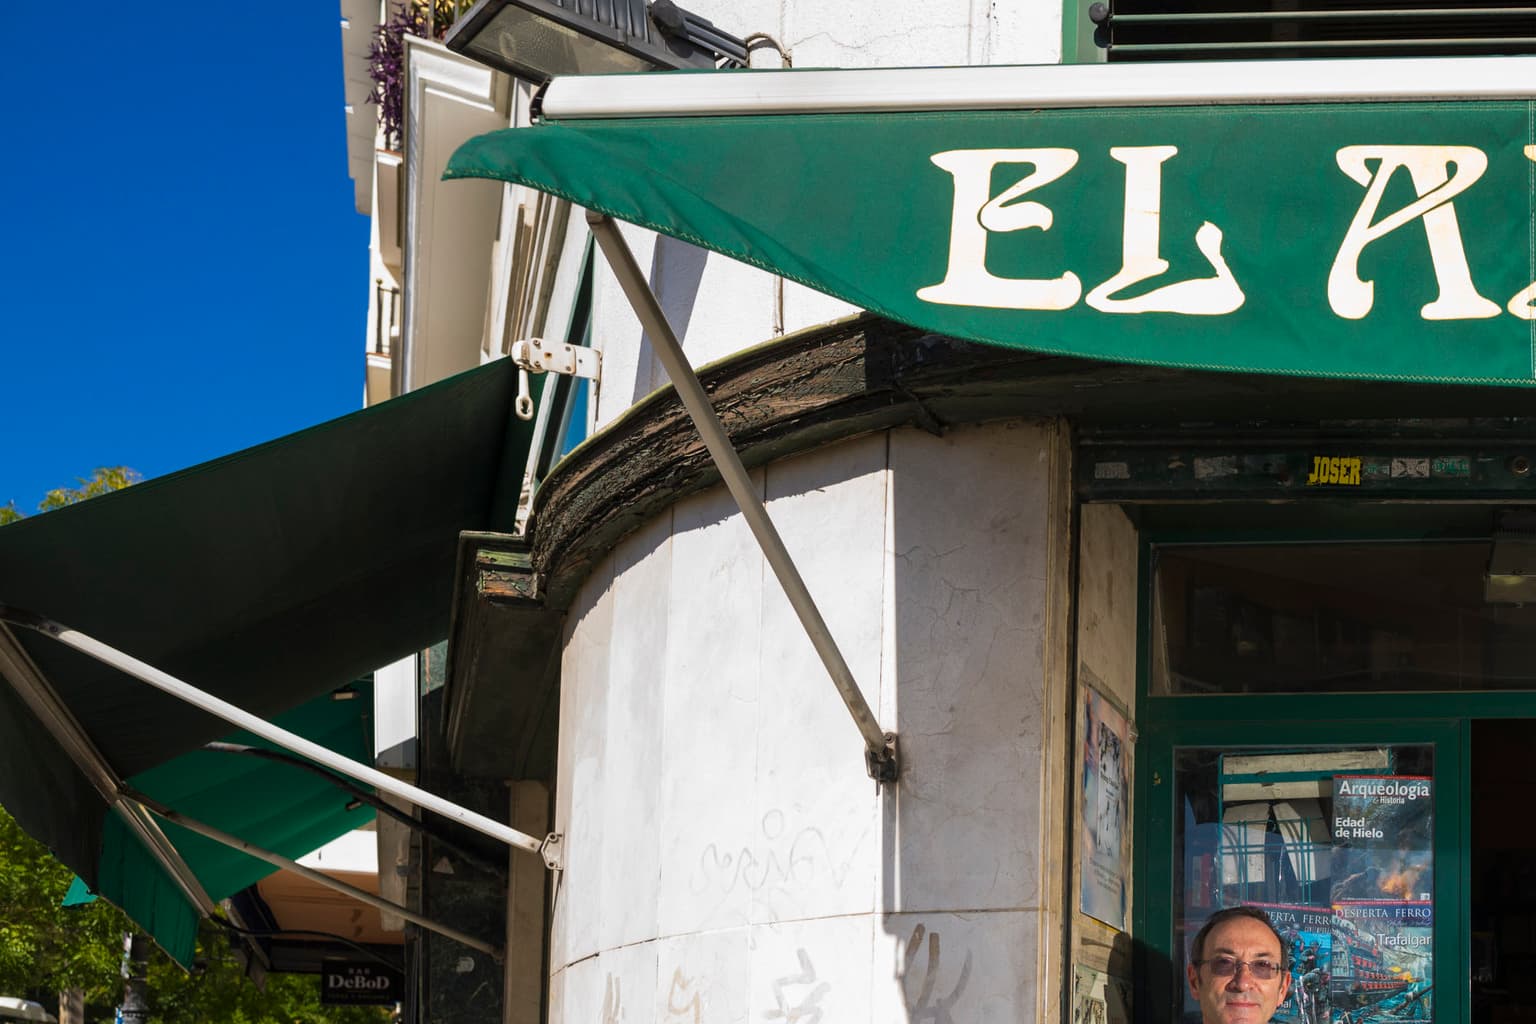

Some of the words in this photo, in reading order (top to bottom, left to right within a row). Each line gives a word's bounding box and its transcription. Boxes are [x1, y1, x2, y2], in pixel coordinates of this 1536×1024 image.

[916, 146, 1245, 315] EL
[1308, 456, 1362, 486] JOSER
[1339, 780, 1430, 800] Arqueología
[1380, 796, 1405, 805] Historia
[1335, 817, 1365, 828] Edad
[1335, 828, 1350, 839] de
[1353, 828, 1384, 839] Hielo
[1269, 910, 1296, 922] PERTA
[1303, 914, 1332, 926] FERR
[1336, 908, 1388, 919] DESPERTA
[1395, 908, 1432, 918] FERRO
[1376, 932, 1432, 948] Trafalgar
